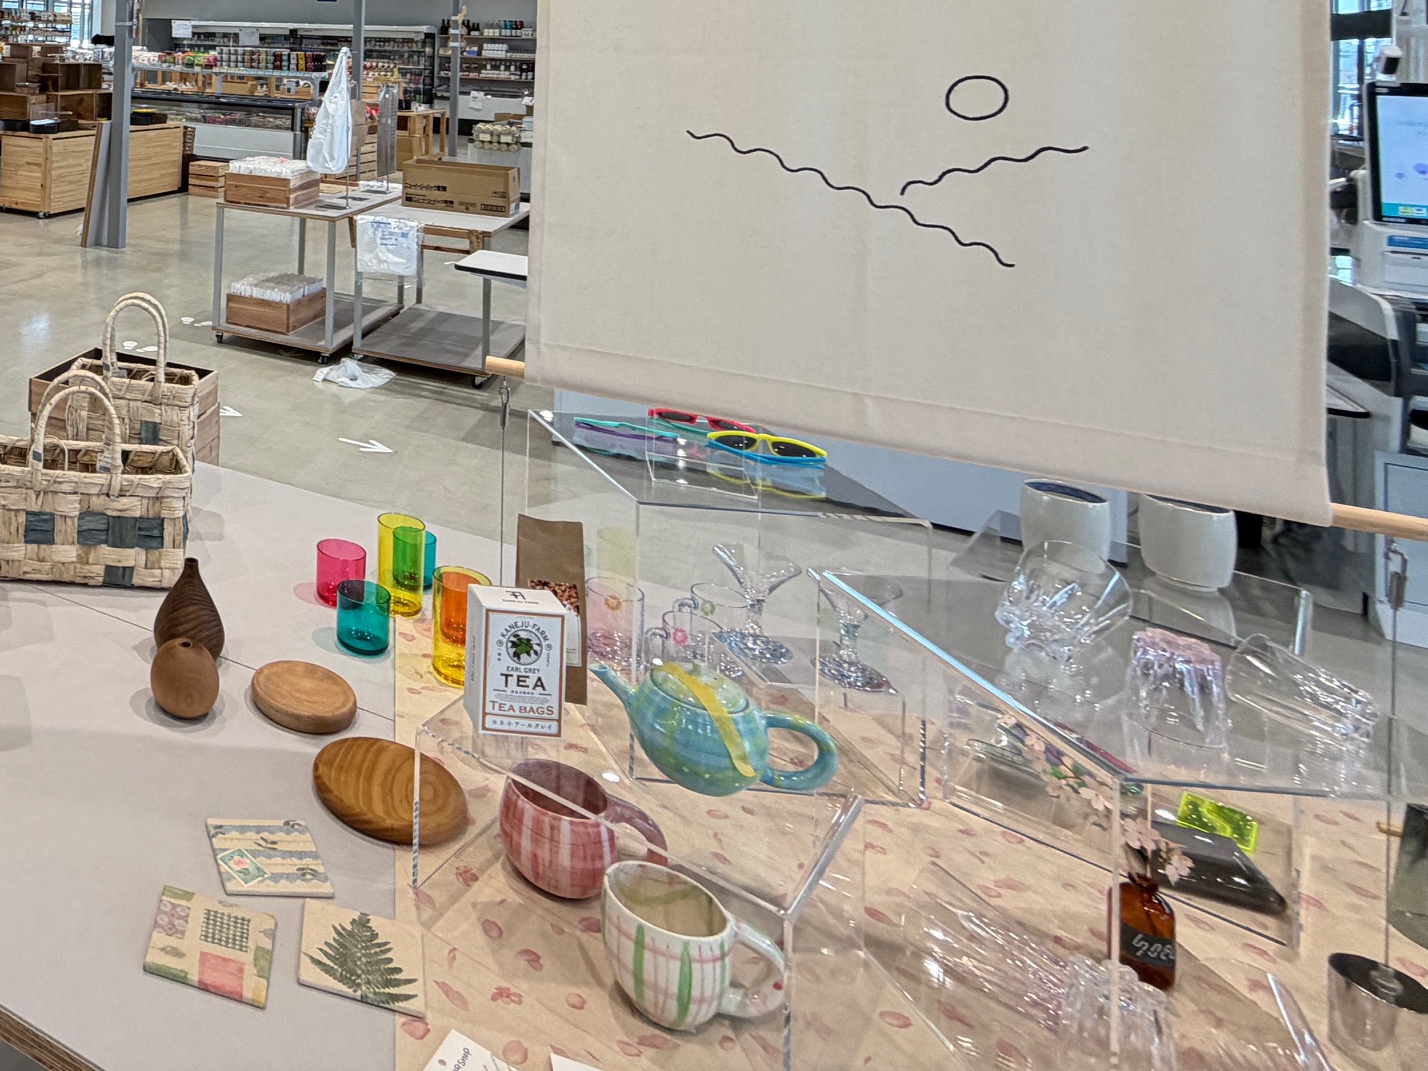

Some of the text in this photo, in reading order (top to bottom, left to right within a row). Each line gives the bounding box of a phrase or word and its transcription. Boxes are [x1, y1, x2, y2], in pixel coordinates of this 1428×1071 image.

[500, 620, 550, 643] KANEJU-FARM
[506, 665, 523, 674] EARL
[500, 673, 547, 692] TEA
[489, 700, 555, 716] TEA BAGS
